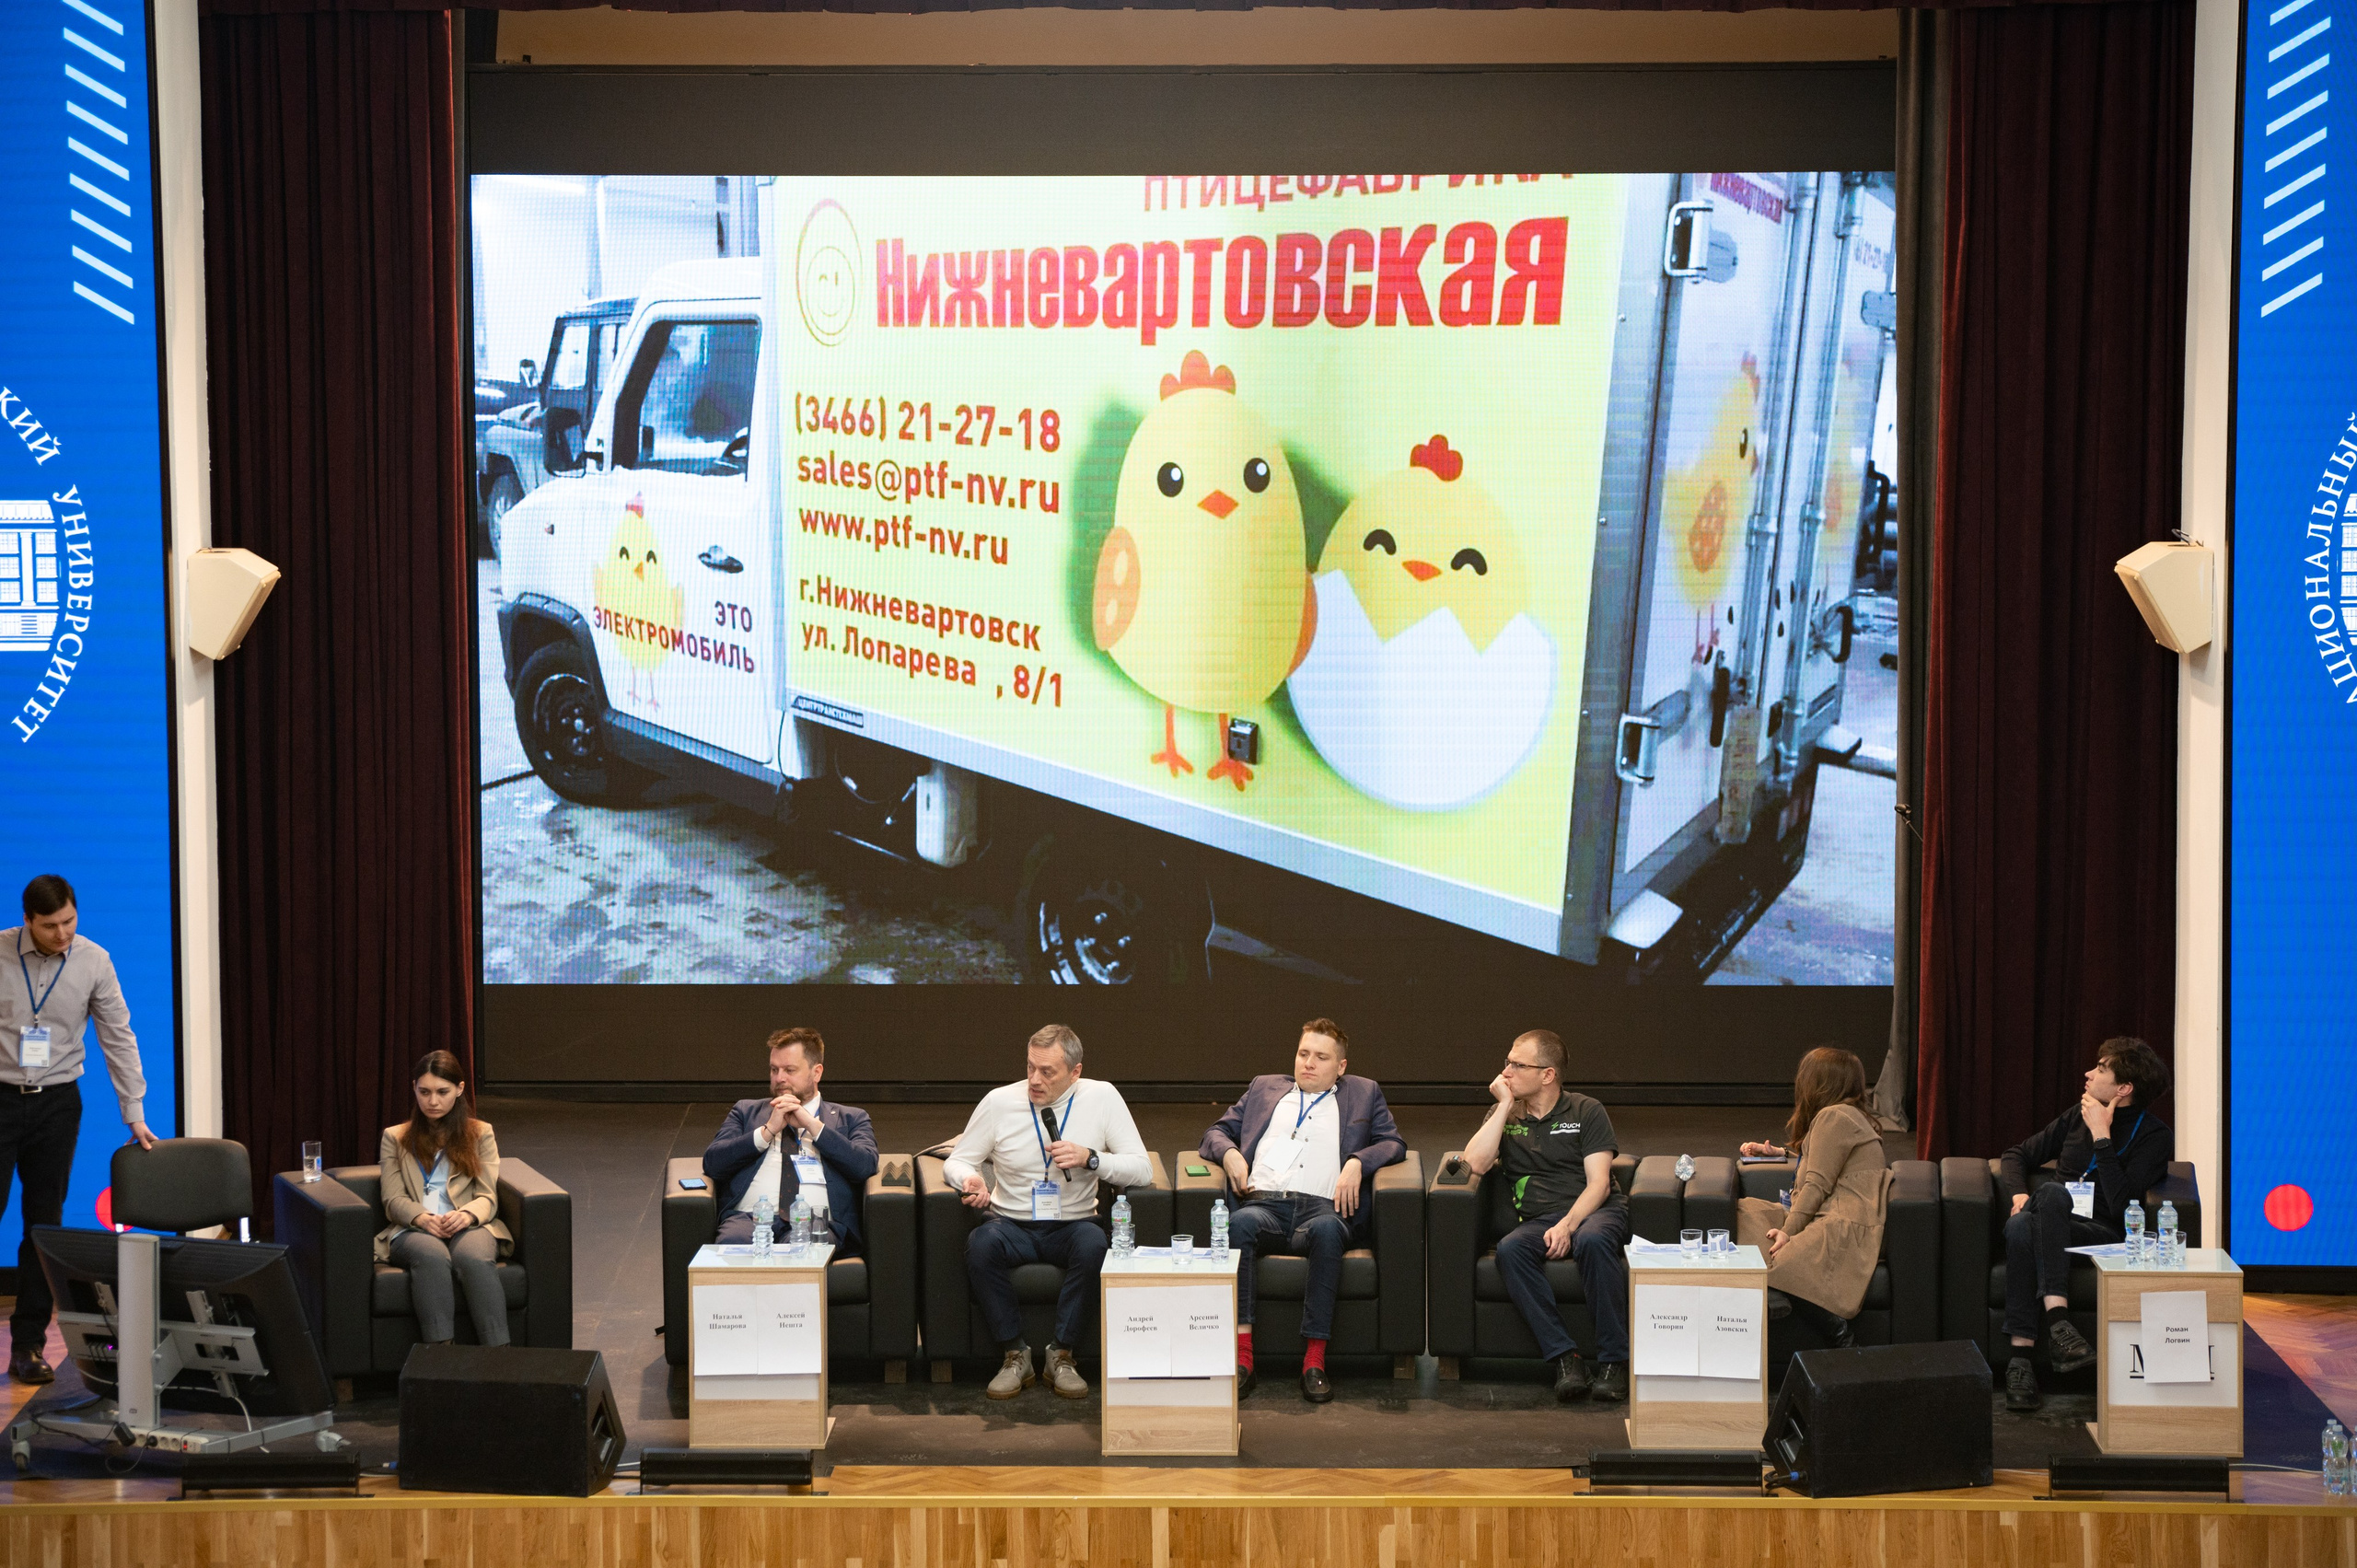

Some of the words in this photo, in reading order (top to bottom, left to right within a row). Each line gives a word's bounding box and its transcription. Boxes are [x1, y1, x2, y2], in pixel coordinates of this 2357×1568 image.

[1144, 173, 1573, 213] ПТИЦЕФА
[876, 216, 1569, 345] Нижневартовская
[795, 391, 886, 442] (3466)
[899, 401, 1060, 452] 21-27-18
[797, 449, 1060, 513] sales@ptf-nv.ru
[798, 507, 1008, 564] www.ptf-nv.ru
[2305, 412, 2357, 703] ЦИОНАЛЬНЫ
[11, 484, 93, 743] УНИВЕРСИТЕТ
[593, 605, 755, 674] ЭЛЕКТРОМОБИЛЬ
[714, 600, 753, 633] ЭТО
[799, 575, 1041, 651] г.Нижневартовск
[801, 622, 836, 650] ул.
[842, 625, 976, 686] Лопарева
[1013, 665, 1062, 707] 8/1
[1127, 1314, 1154, 1323] Андрей
[1650, 1313, 1689, 1321] Александр
[1715, 1325, 1748, 1333] Азовских
[1716, 1315, 1747, 1323] Наталья
